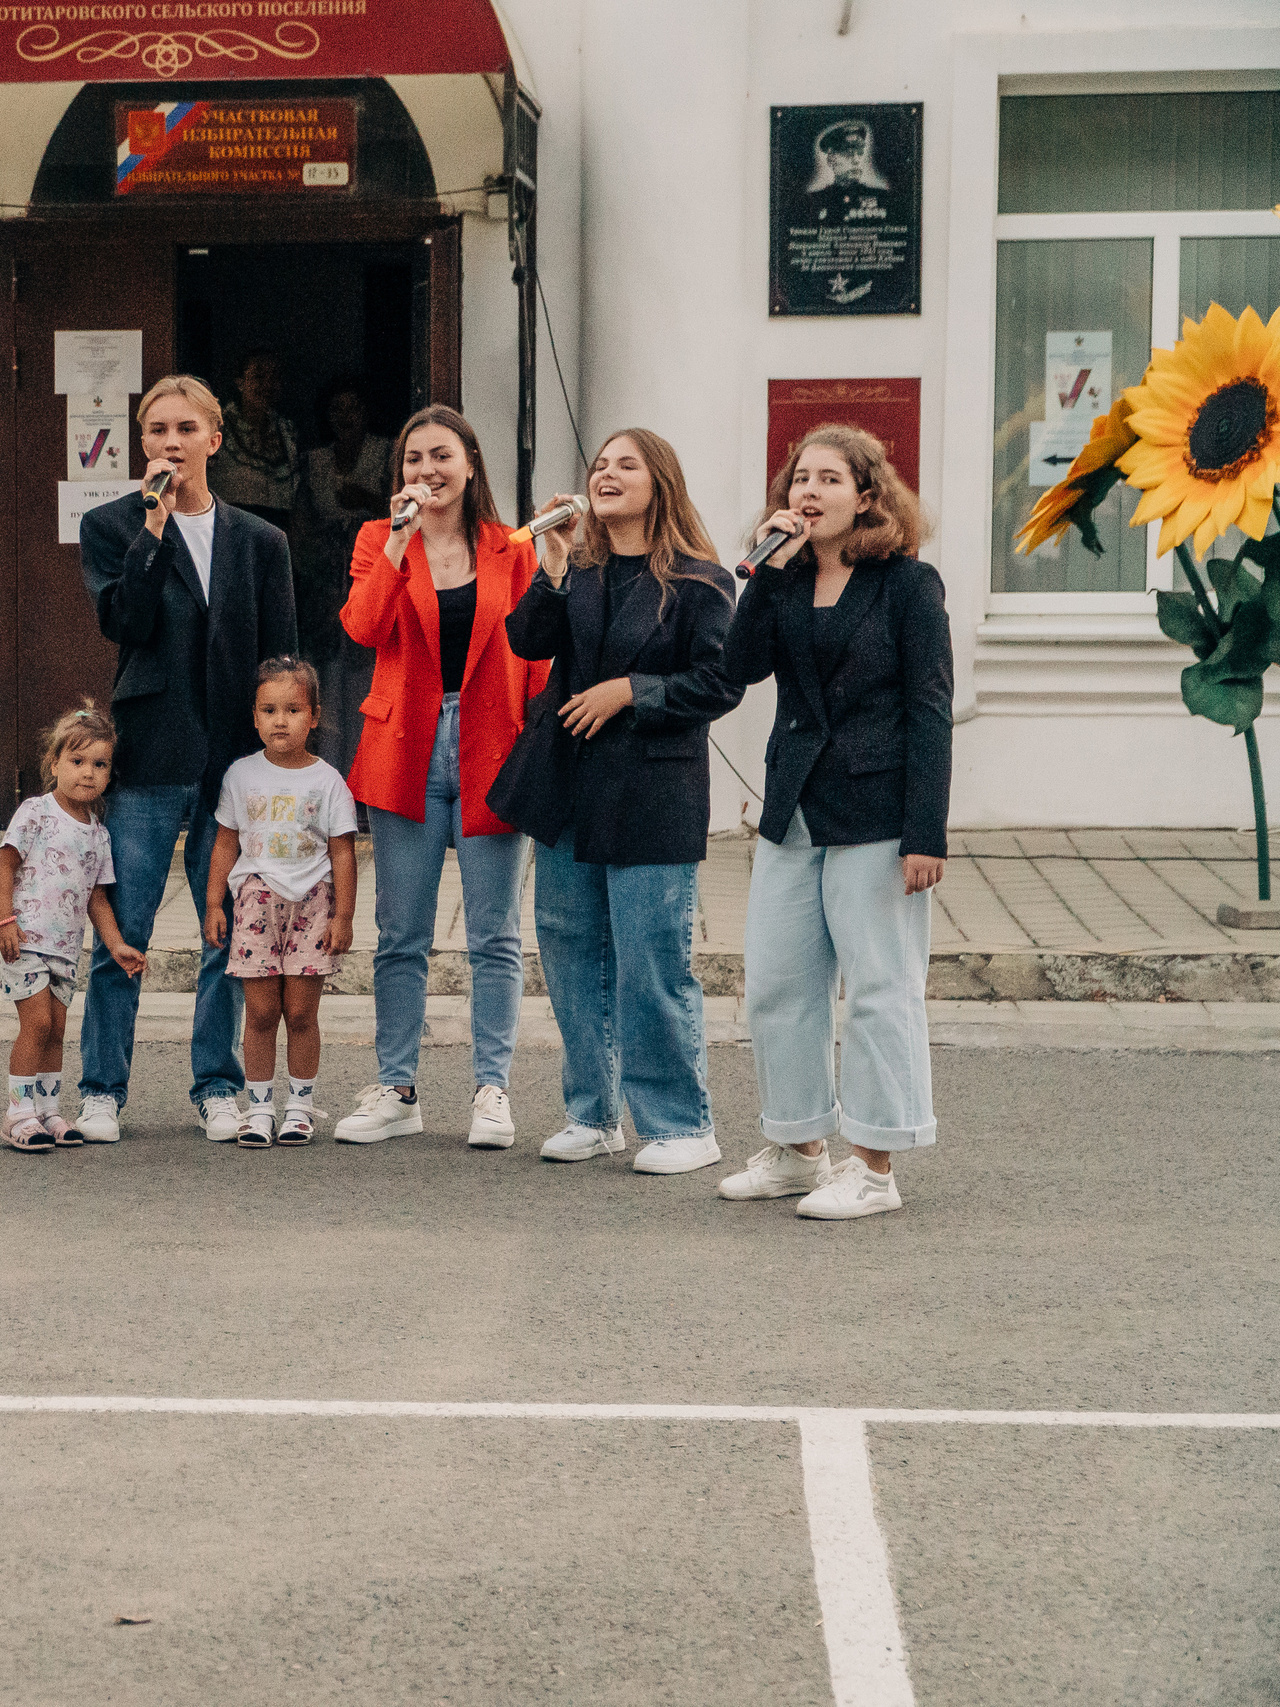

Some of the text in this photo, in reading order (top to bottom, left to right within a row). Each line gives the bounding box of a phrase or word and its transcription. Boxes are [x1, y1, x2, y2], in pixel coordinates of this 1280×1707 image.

[151, 2, 253, 19] СЕЛЬСКОГО
[258, 0, 367, 17] ПОСЕЛЕНИЯ
[201, 108, 319, 124] УЧАСТКОВАЯ
[183, 127, 338, 142] ИЗБИРАТЕЛЬНАЯ
[209, 145, 311, 159] КОМИССИЯ
